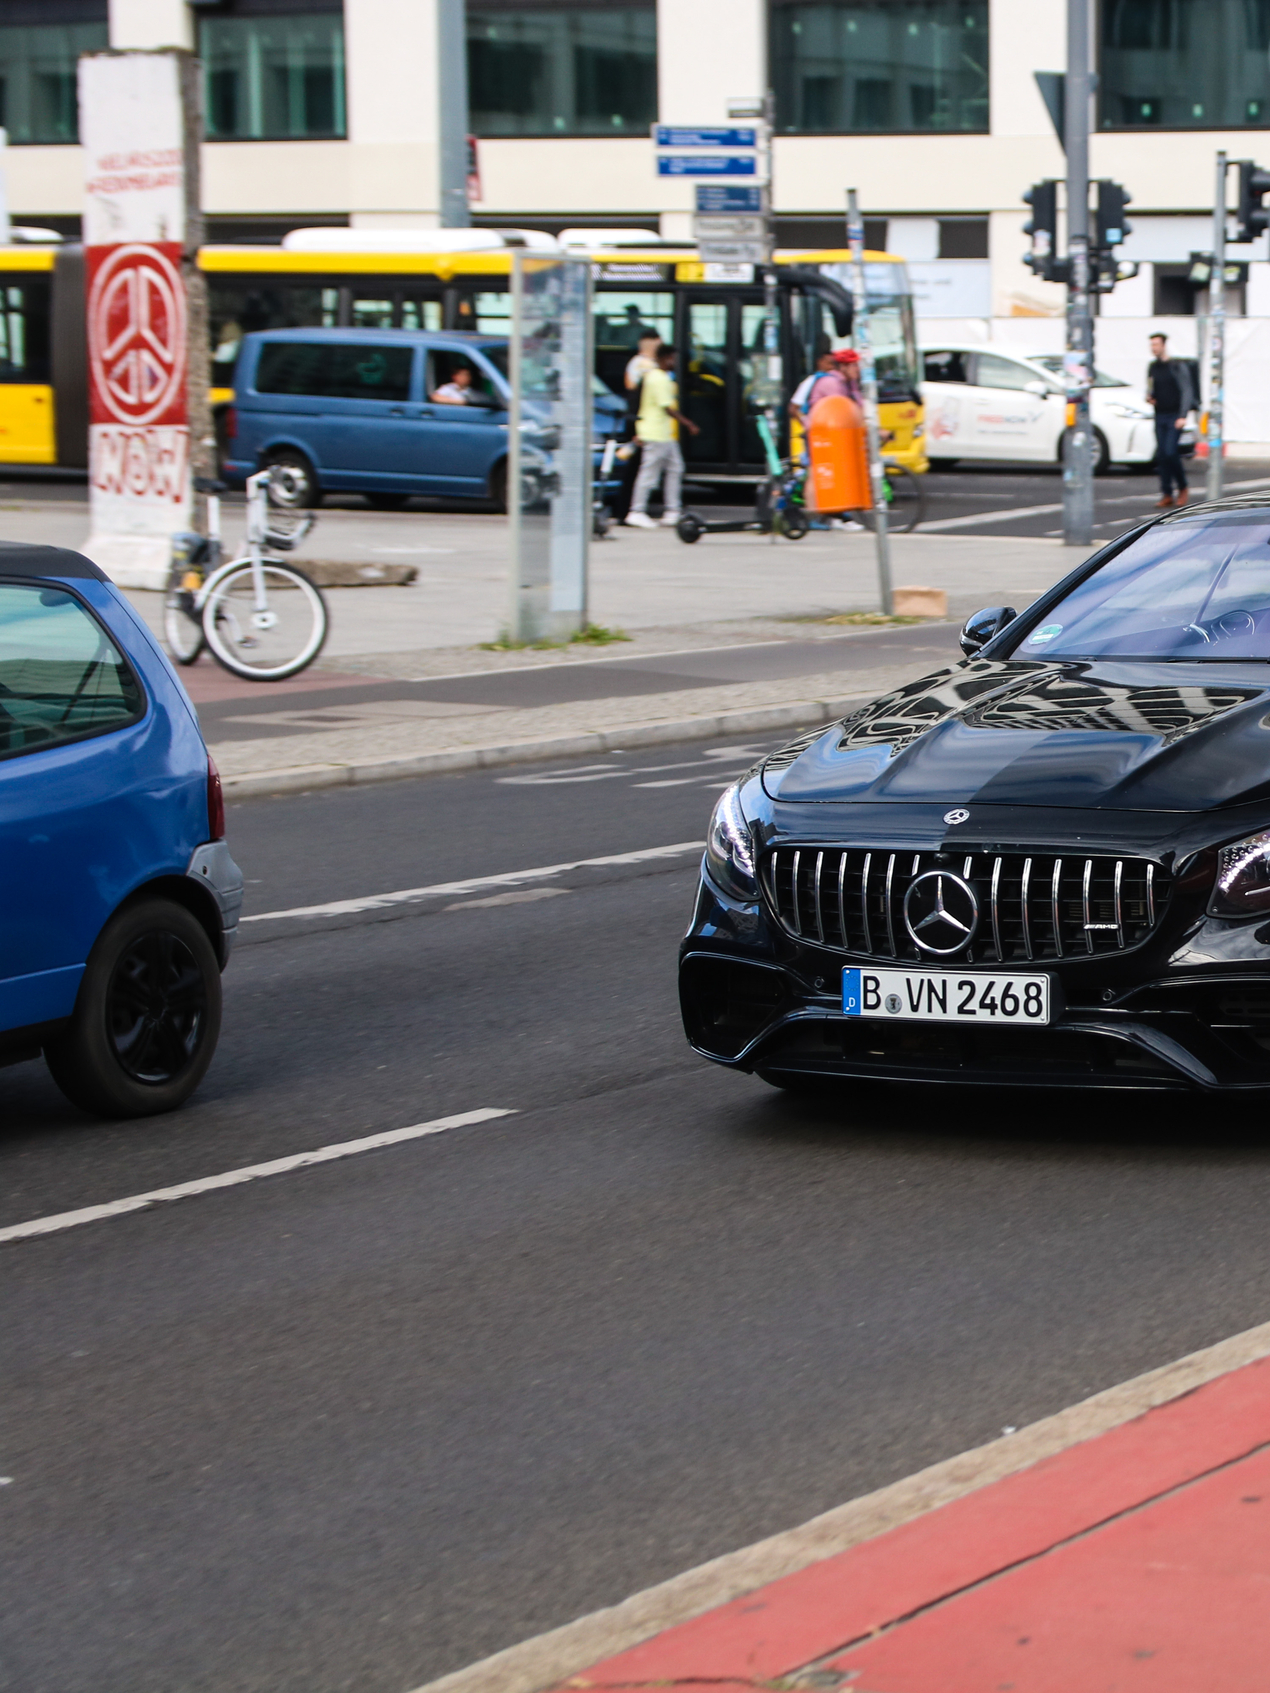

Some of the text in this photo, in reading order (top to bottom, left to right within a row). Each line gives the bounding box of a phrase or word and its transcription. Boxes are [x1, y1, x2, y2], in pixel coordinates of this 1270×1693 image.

[849, 997, 856, 1007] D
[863, 975, 1043, 1018] B VN 2468
